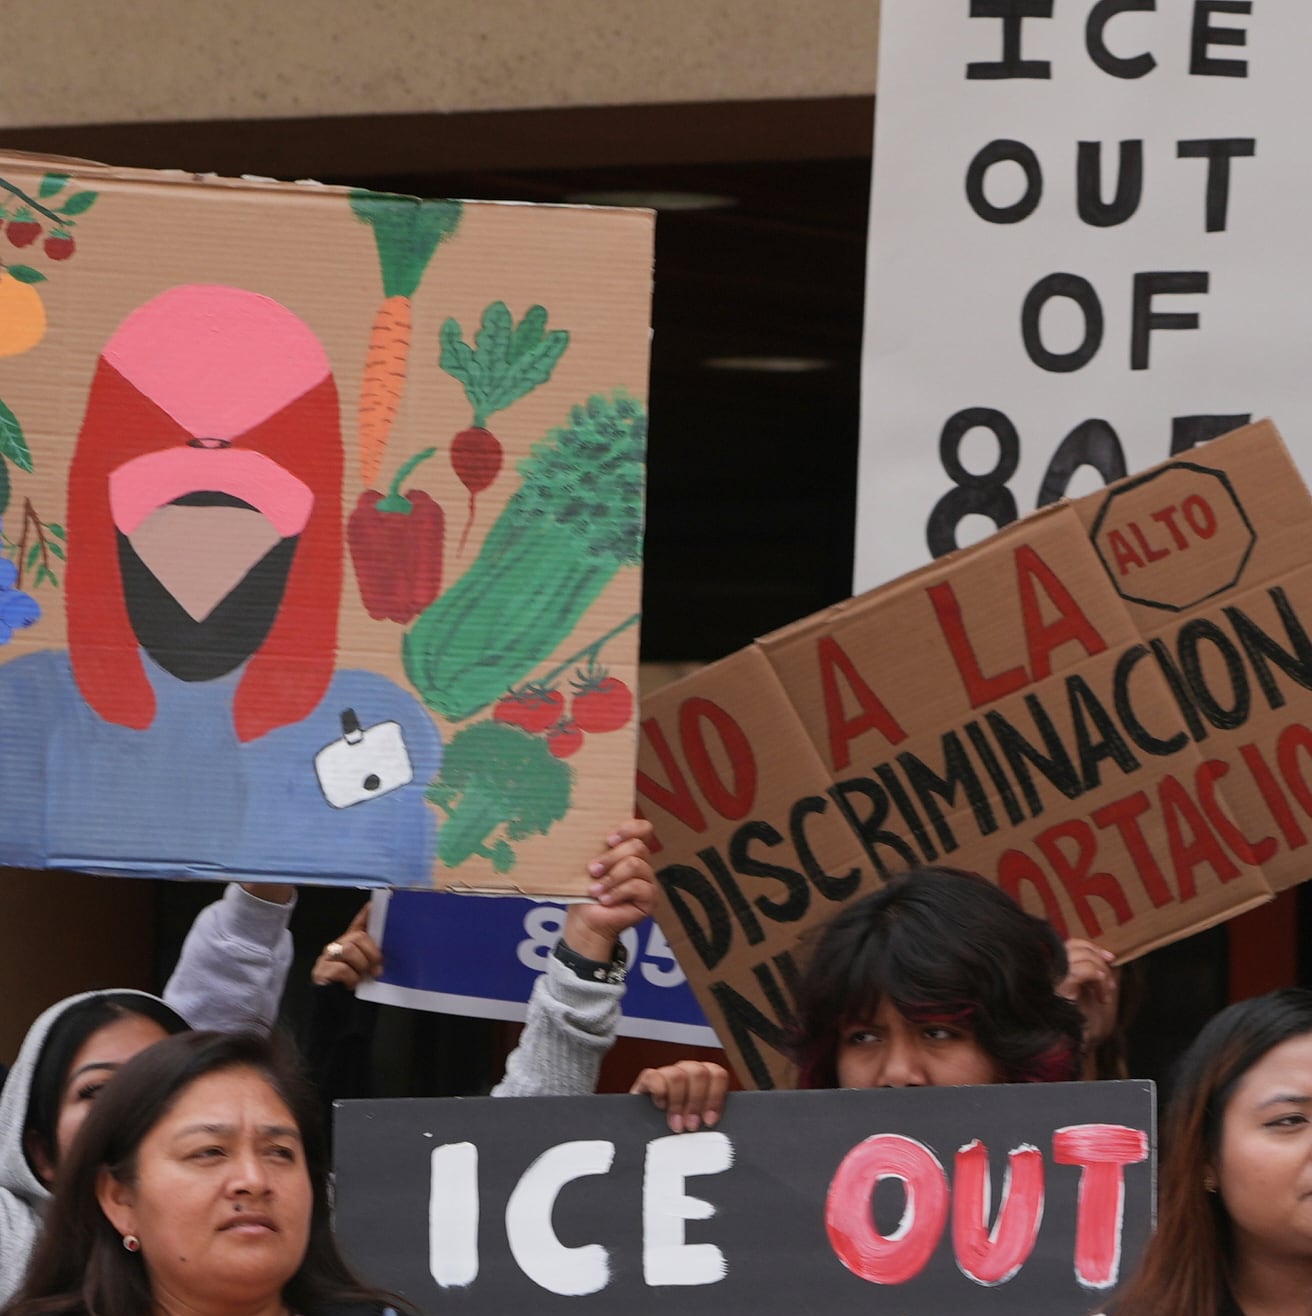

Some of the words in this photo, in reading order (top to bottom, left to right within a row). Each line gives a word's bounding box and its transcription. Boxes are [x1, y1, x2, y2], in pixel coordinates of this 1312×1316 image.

[965, 0, 1253, 80] ICE
[965, 138, 1257, 232] OUT
[1020, 270, 1211, 373] OF
[1106, 492, 1218, 577] ALTO
[635, 696, 759, 854] NO
[818, 636, 909, 773] A
[924, 543, 1109, 710] LA
[517, 906, 686, 988] 85
[428, 1130, 735, 1297] ICE
[824, 1123, 1150, 1290] OUT
